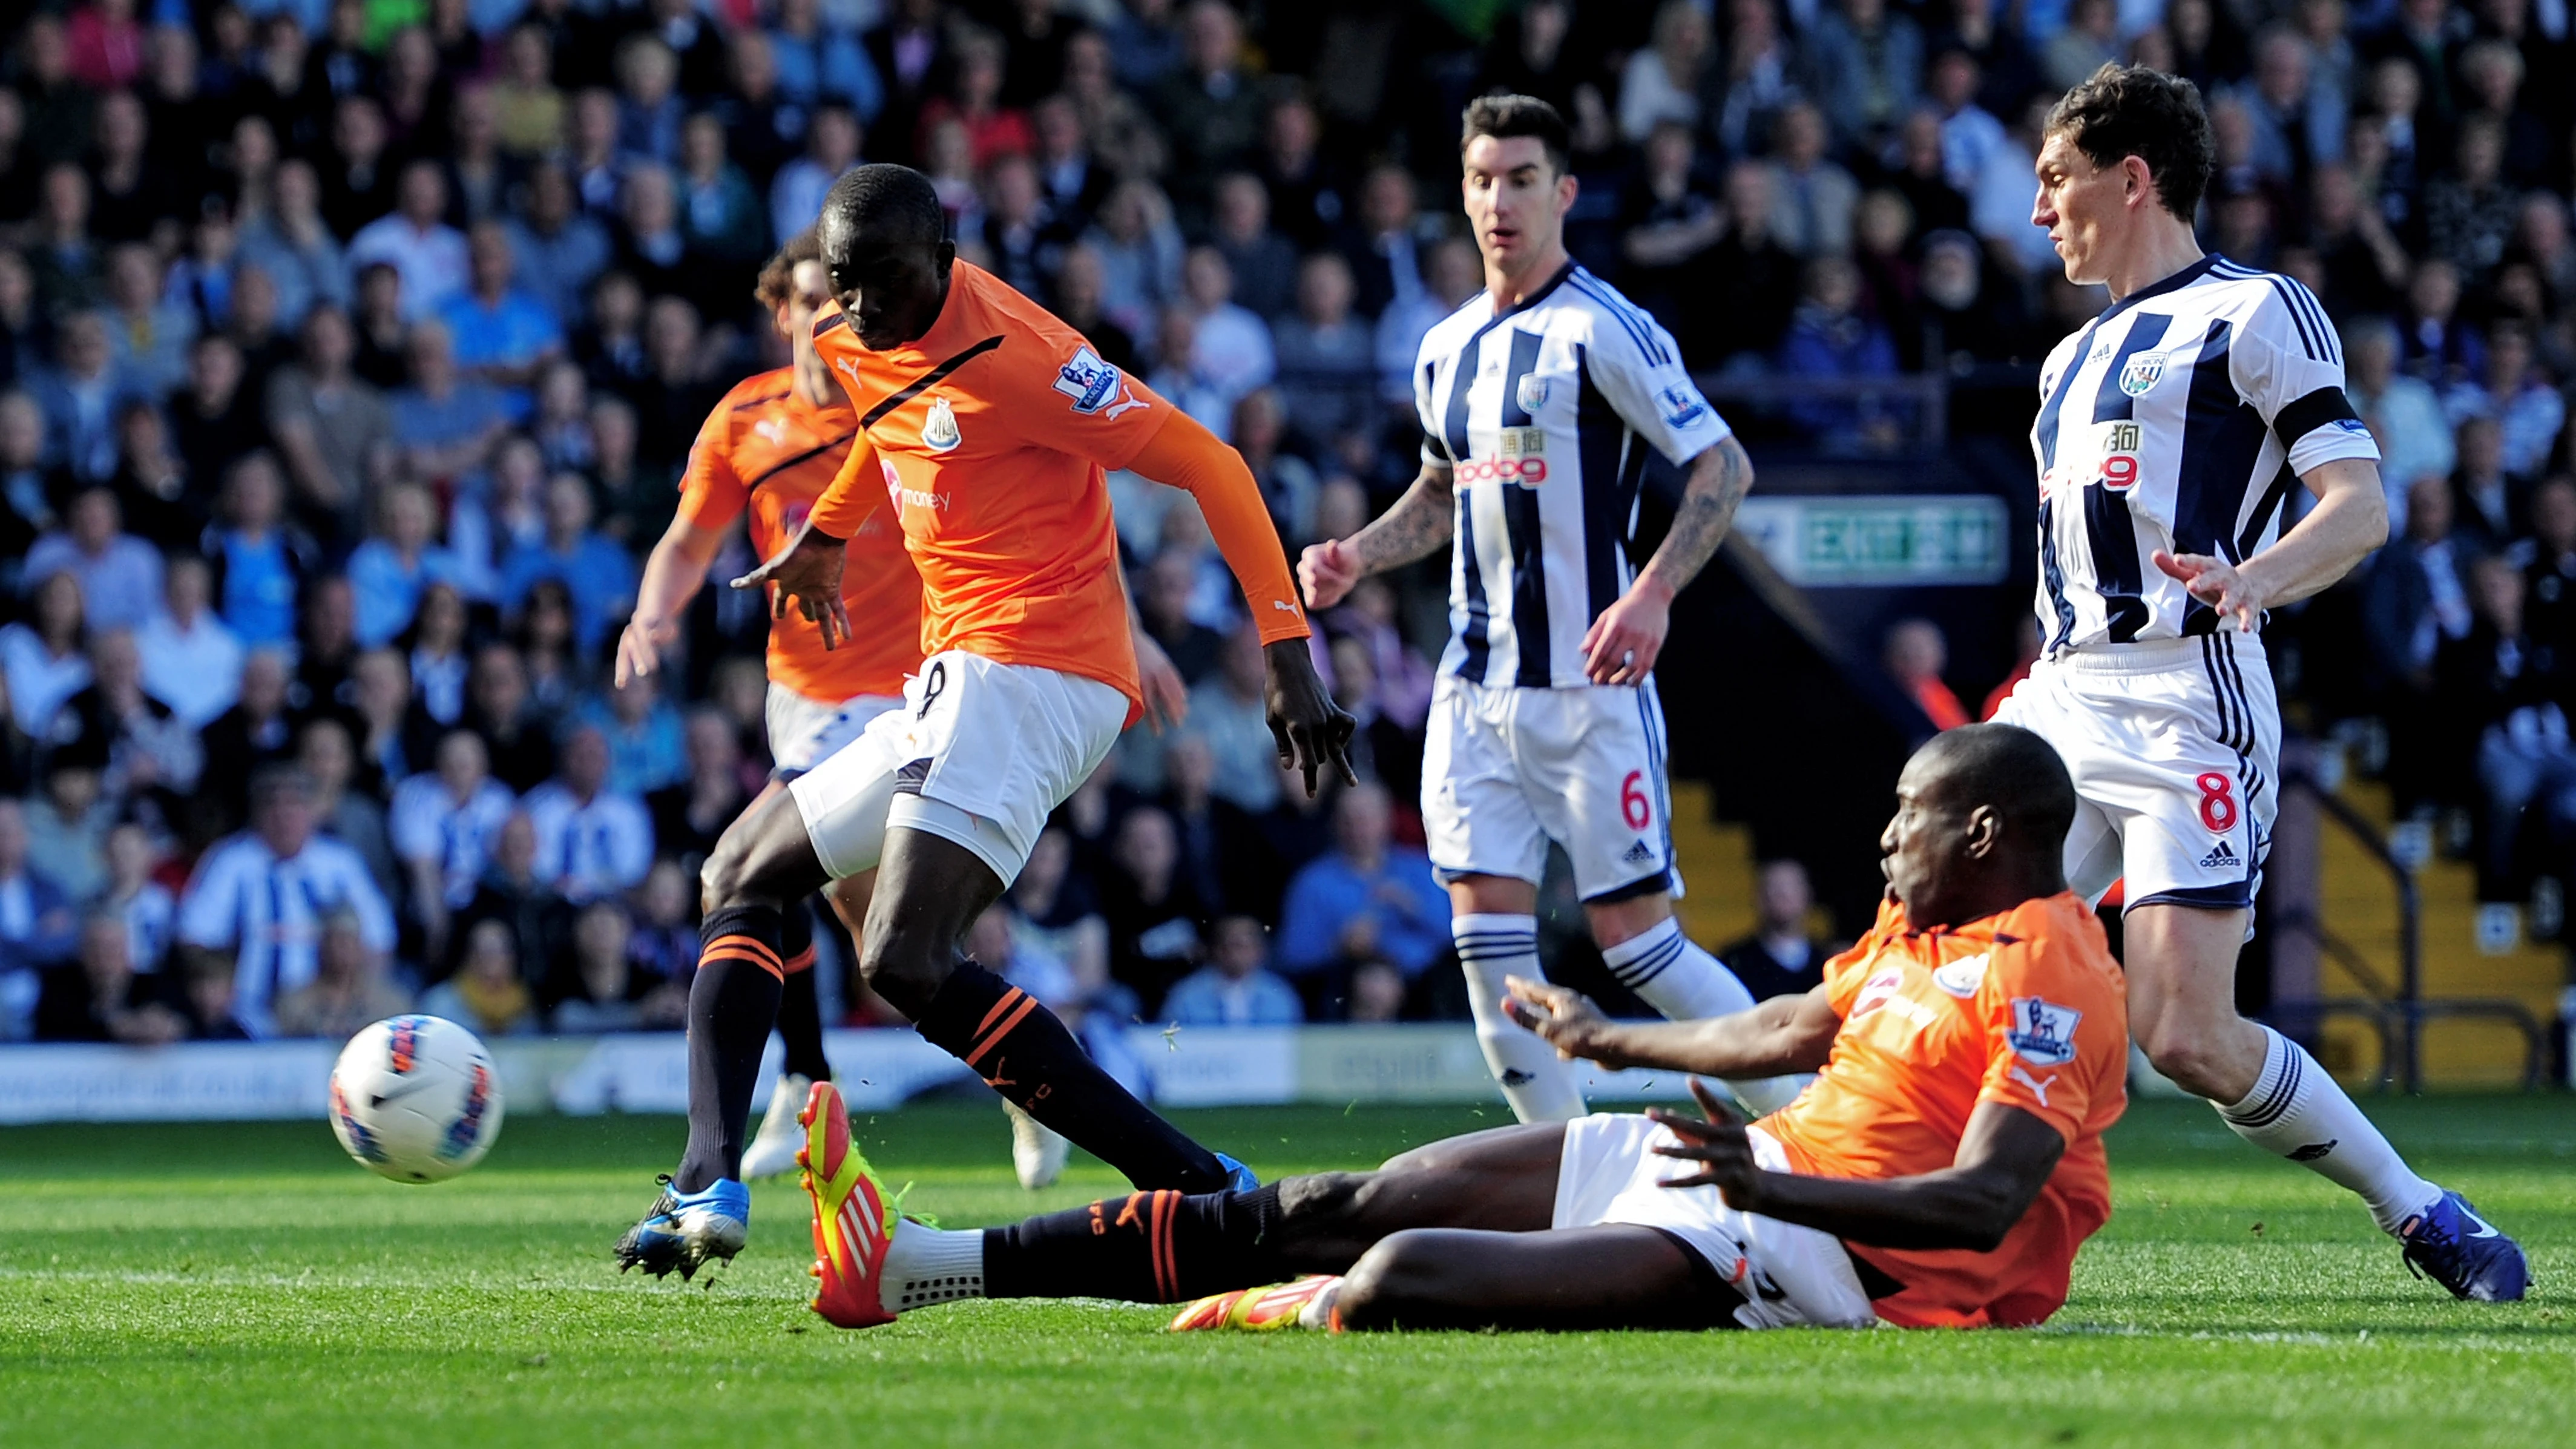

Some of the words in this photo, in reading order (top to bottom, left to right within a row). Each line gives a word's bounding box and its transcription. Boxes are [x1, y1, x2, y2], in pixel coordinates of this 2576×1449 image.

[902, 488, 951, 512] money
[1620, 769, 1651, 833] 6
[2196, 772, 2238, 834] 8
[2200, 856, 2241, 868] adidas
